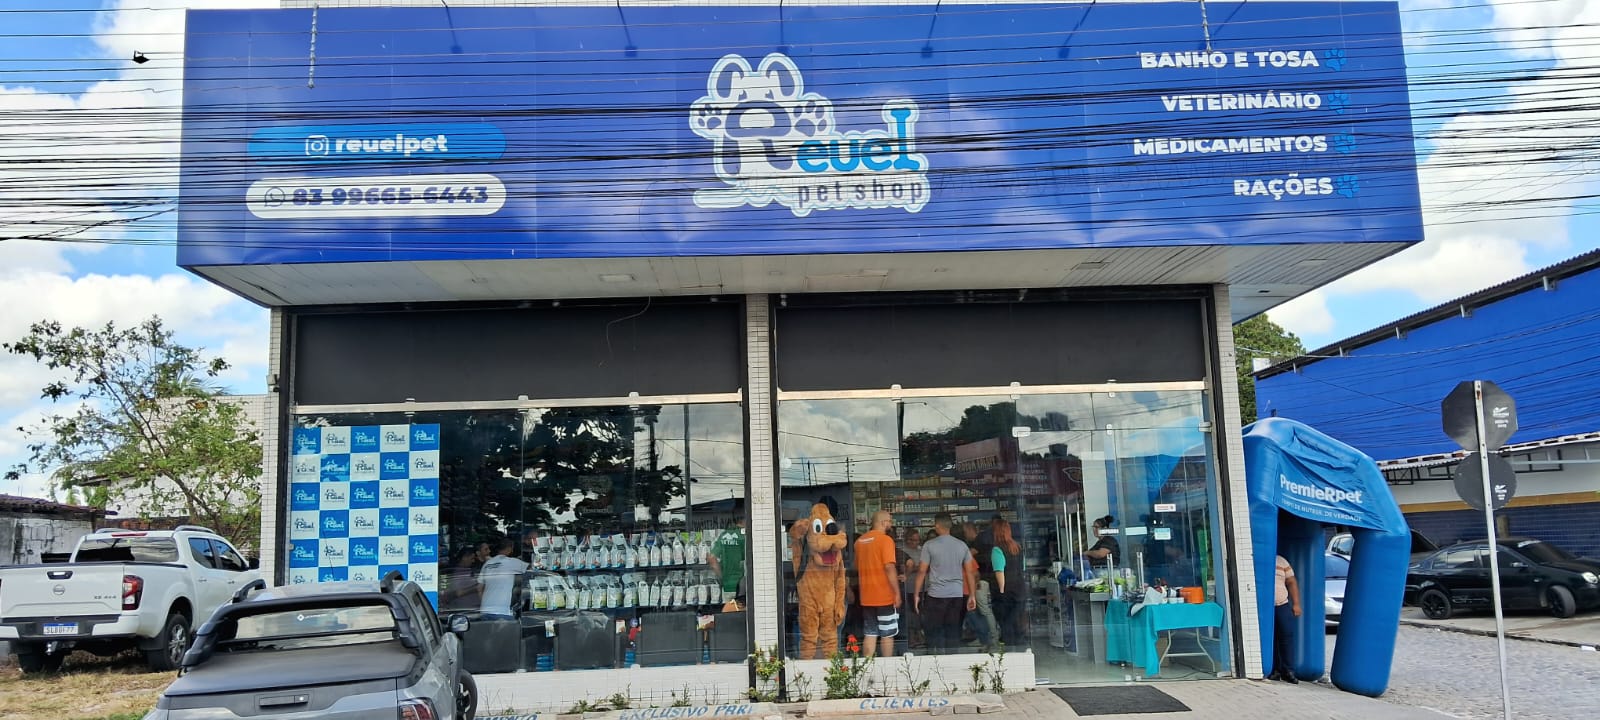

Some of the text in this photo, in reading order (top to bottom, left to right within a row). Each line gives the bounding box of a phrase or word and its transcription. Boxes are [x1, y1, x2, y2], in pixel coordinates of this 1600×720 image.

[1140, 50, 1319, 69] BANHO E TOSA
[1161, 90, 1321, 112] VETERINÁRIO
[335, 133, 448, 157] reuelpet
[713, 93, 921, 176] Reuel
[1133, 135, 1328, 155] MEDICAMENTOS
[293, 186, 489, 206] 83 99665-6443
[798, 179, 922, 204] pet shop
[1233, 173, 1333, 200] RAÇÕES
[1280, 473, 1363, 503] PremieRpet
